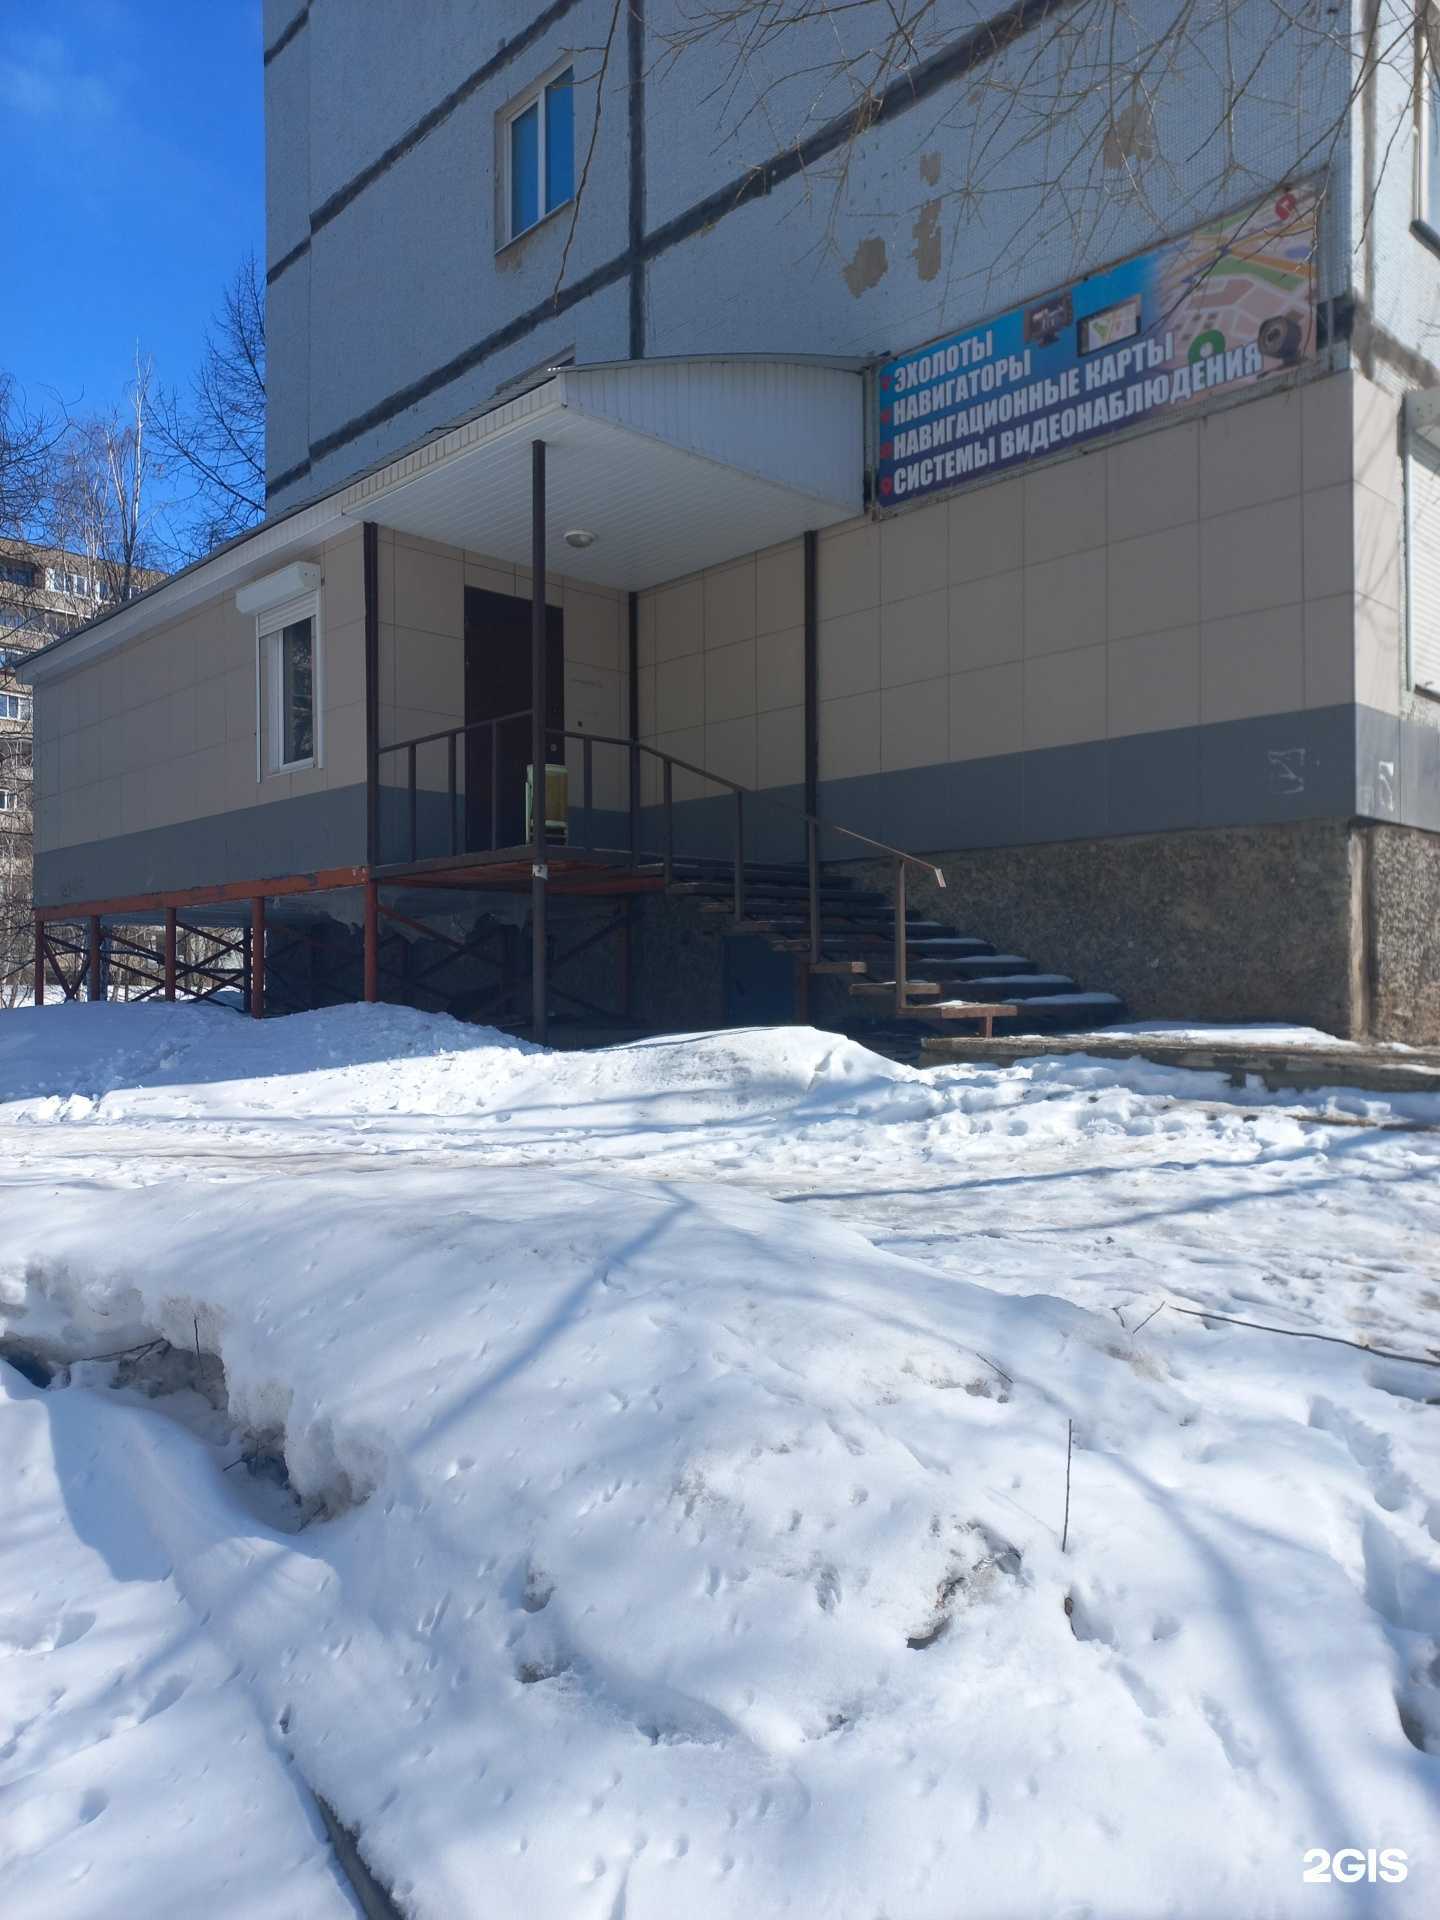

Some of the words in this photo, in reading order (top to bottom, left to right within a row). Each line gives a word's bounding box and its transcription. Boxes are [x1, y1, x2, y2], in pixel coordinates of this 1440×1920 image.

[893, 350, 1031, 426] НАВИГАТОРЫ
[893, 368, 1079, 460] НАВИГАЦИОННЫЕ
[1085, 333, 1174, 390] КАРТЫ
[894, 331, 993, 392] ЭХОЛОТЫ
[893, 441, 996, 495] СИСТЕМЫ
[1000, 344, 1262, 460] ВИДЕОНАБЛЮДЕНИЯ
